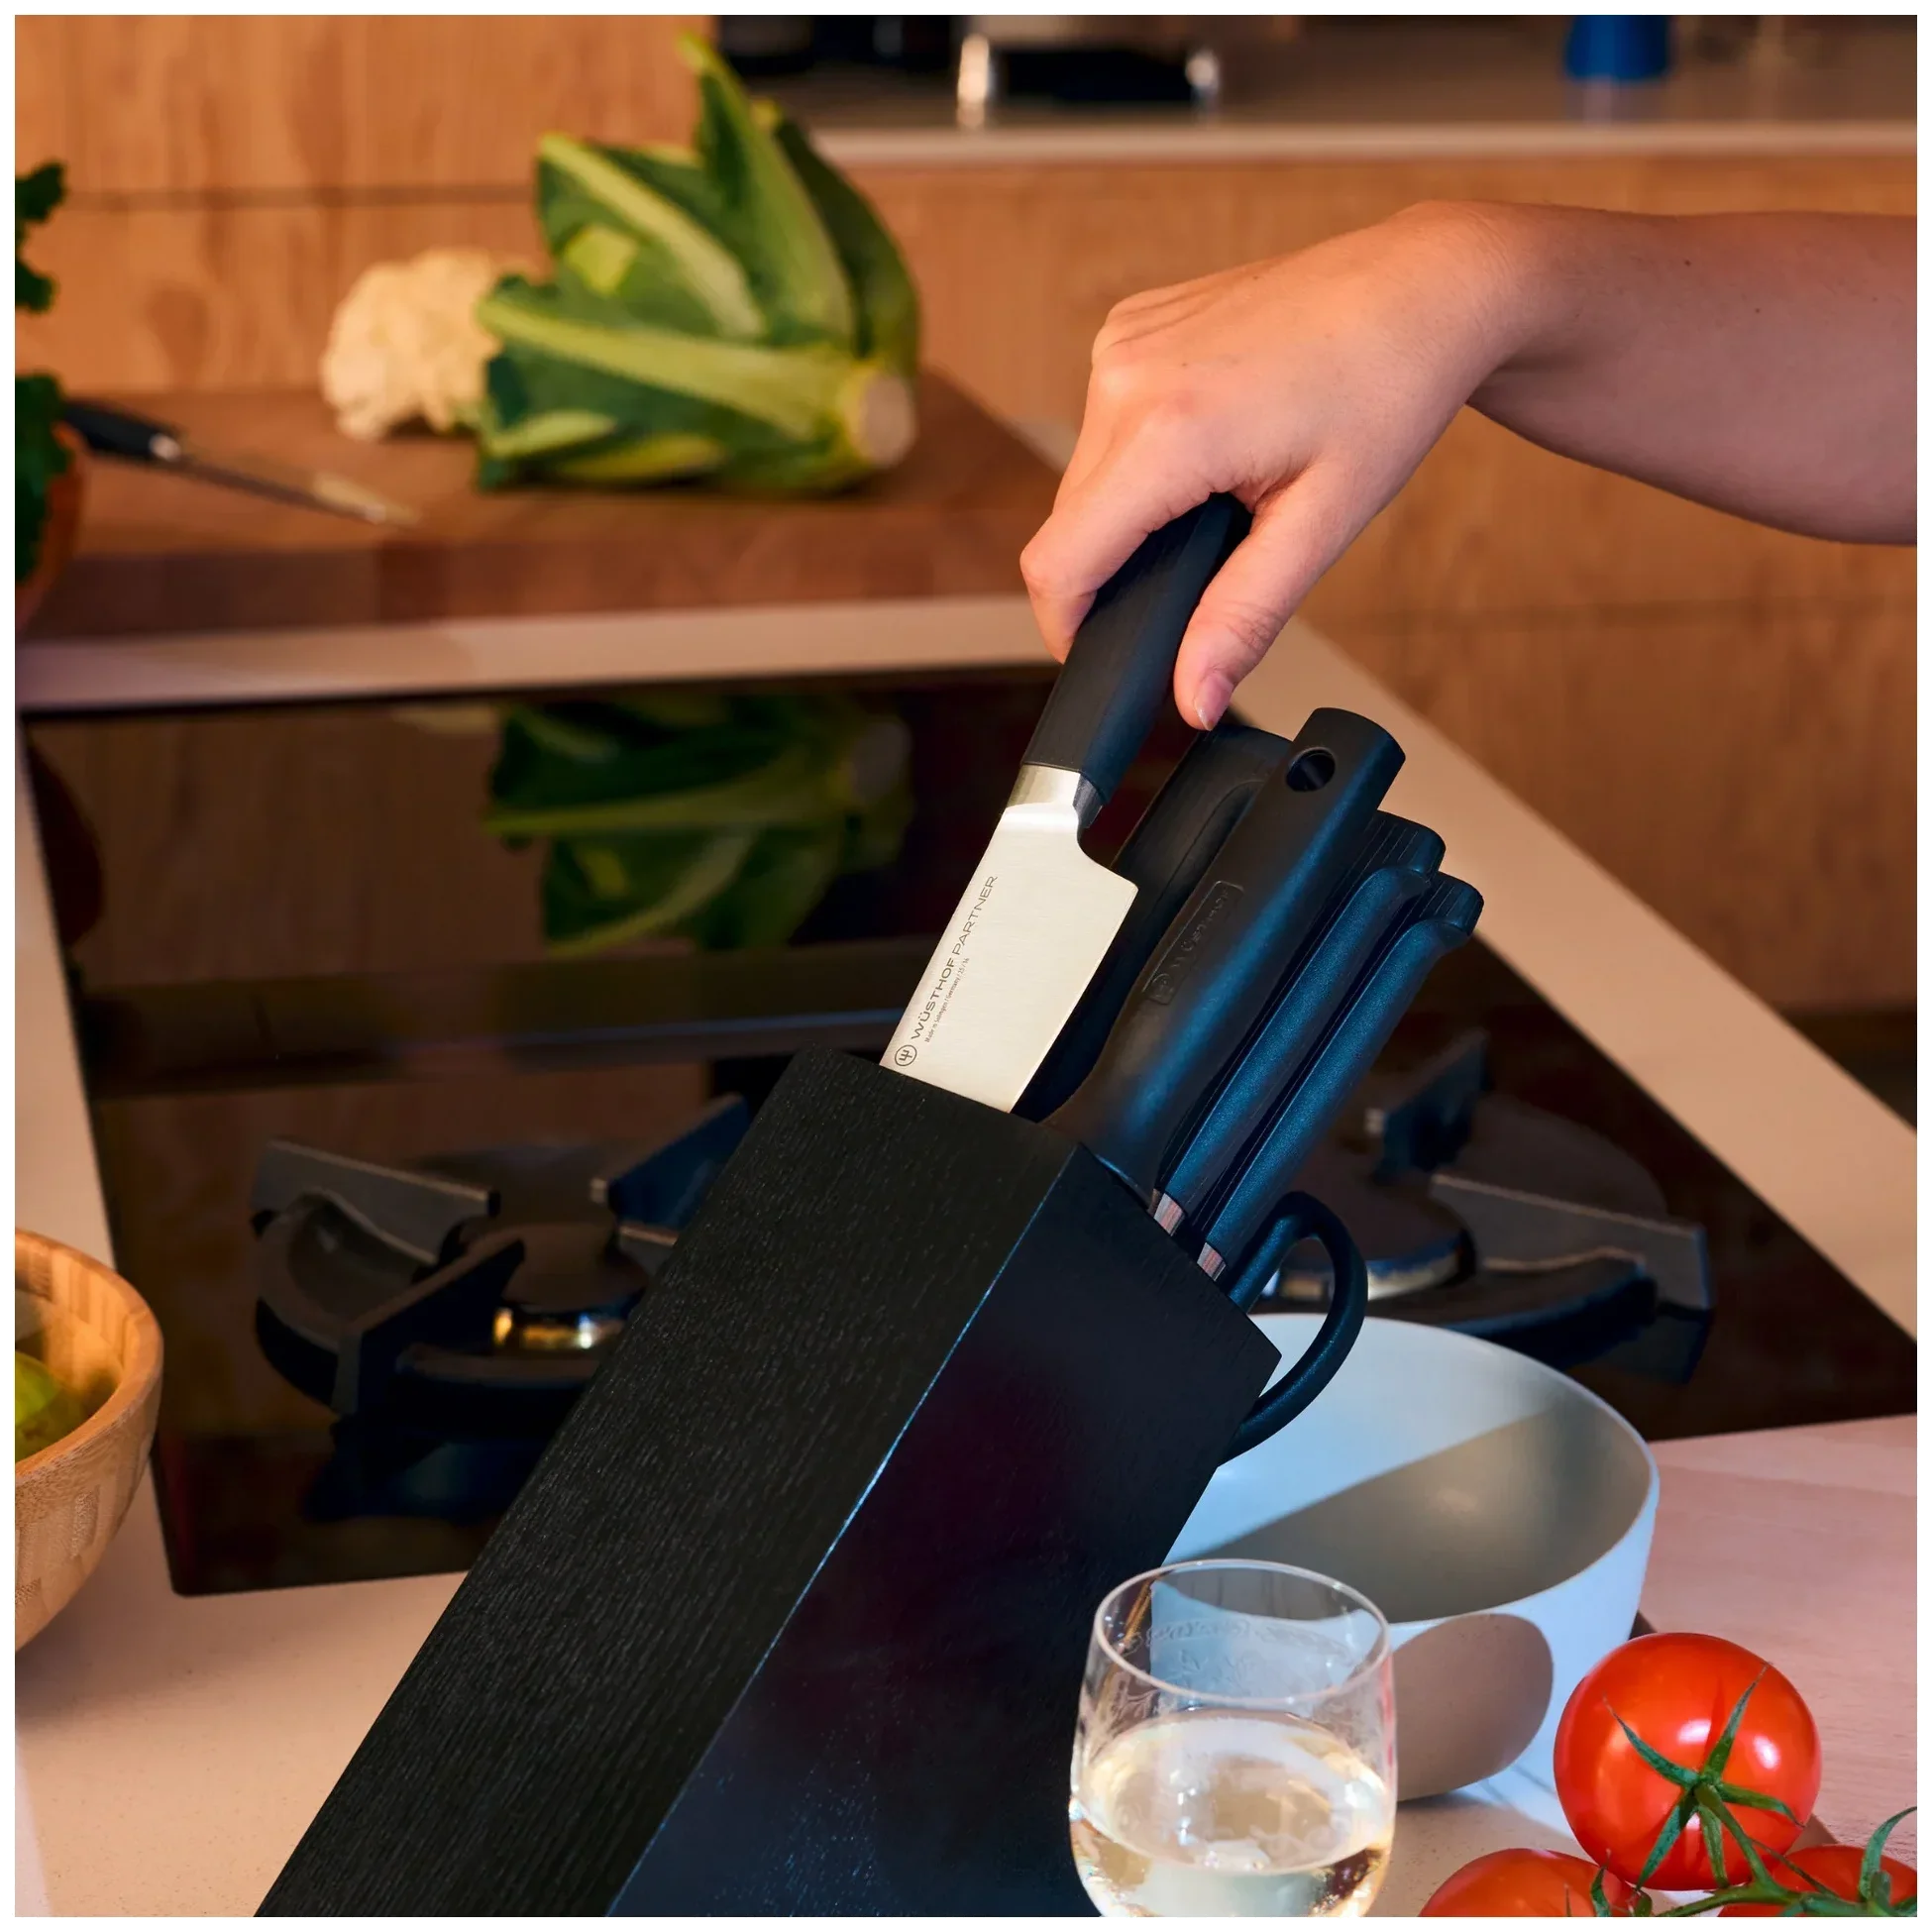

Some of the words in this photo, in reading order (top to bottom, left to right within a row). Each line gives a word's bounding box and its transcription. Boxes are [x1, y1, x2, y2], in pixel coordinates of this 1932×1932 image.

[912, 957, 954, 1040] WÜSTHOF
[952, 876, 998, 955] PARTNER
[935, 1002, 948, 1023] Solingen
[946, 977, 960, 1000] Germany
